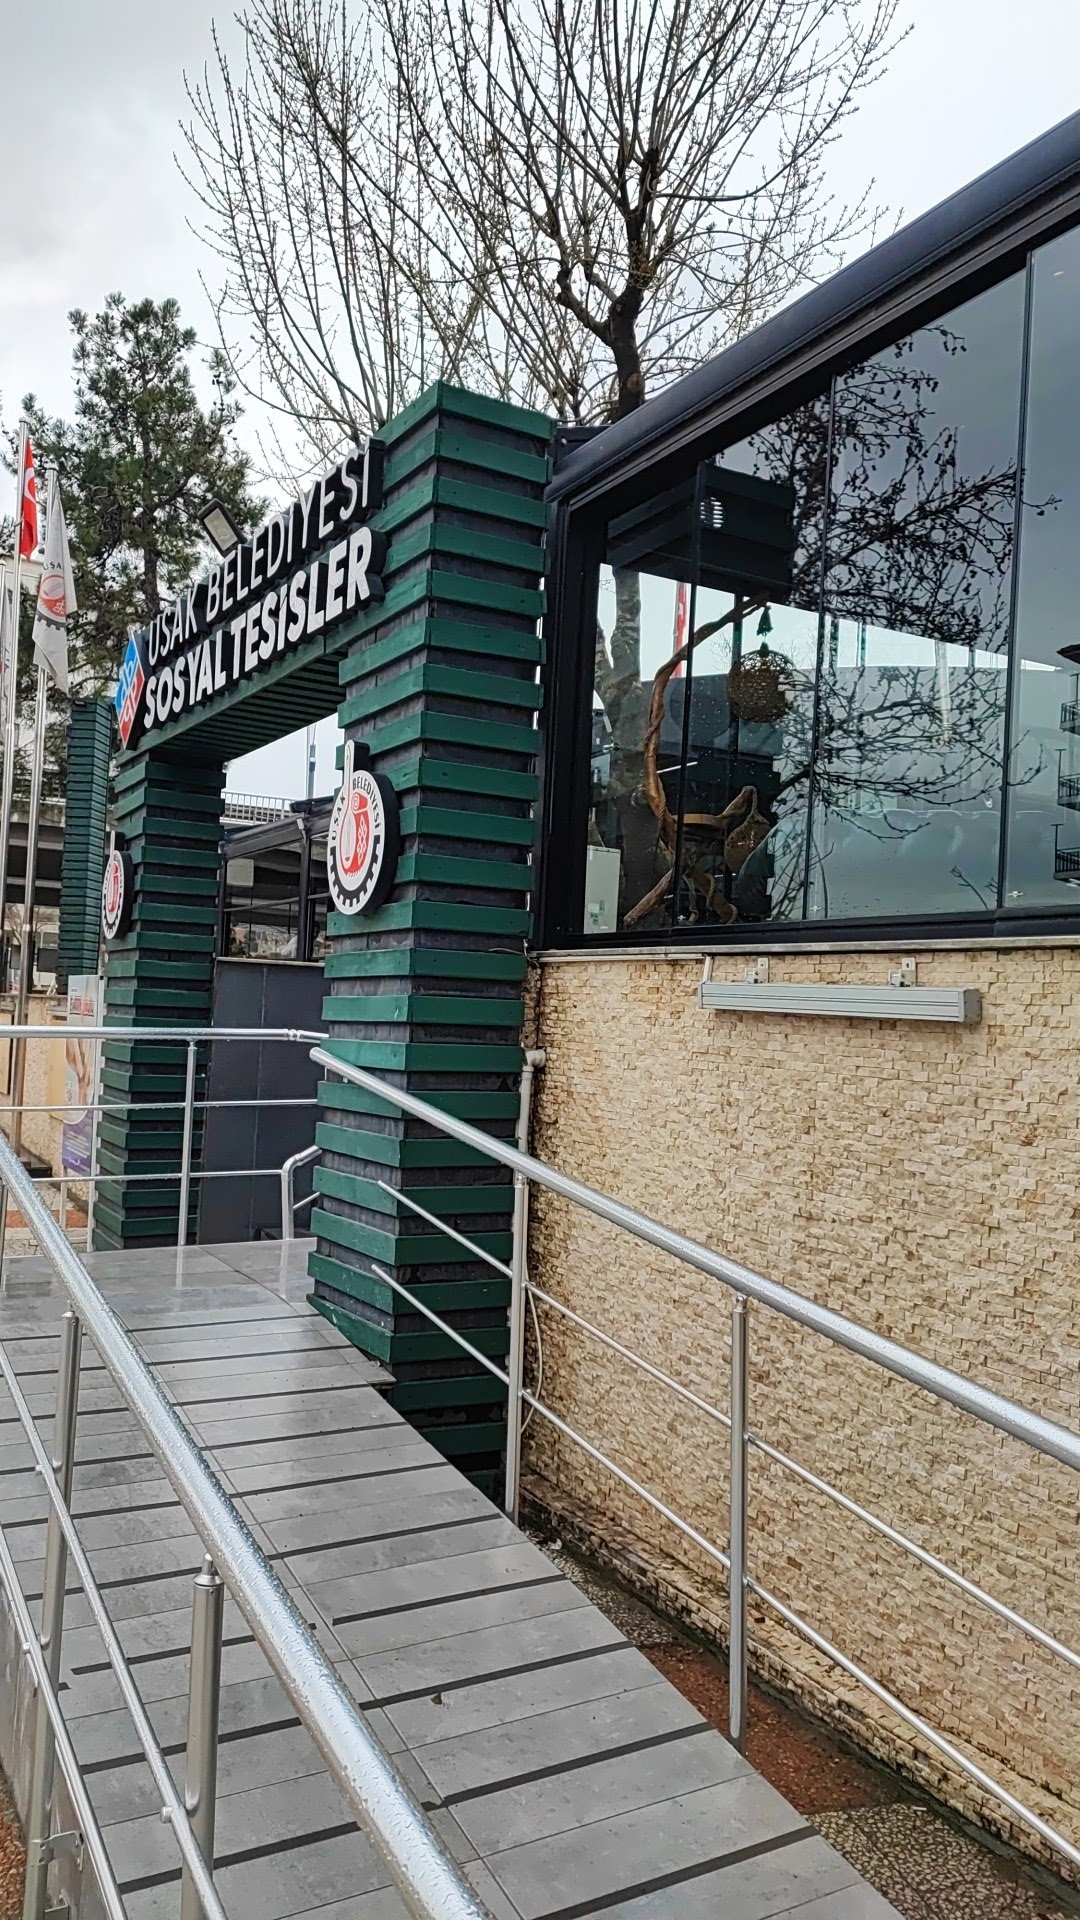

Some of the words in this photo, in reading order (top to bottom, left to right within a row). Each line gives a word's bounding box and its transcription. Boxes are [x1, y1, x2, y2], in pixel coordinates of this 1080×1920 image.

[143, 629, 227, 729] SOSYAL
[230, 526, 373, 680] TESİSLER
[331, 792, 346, 841] UŞAK
